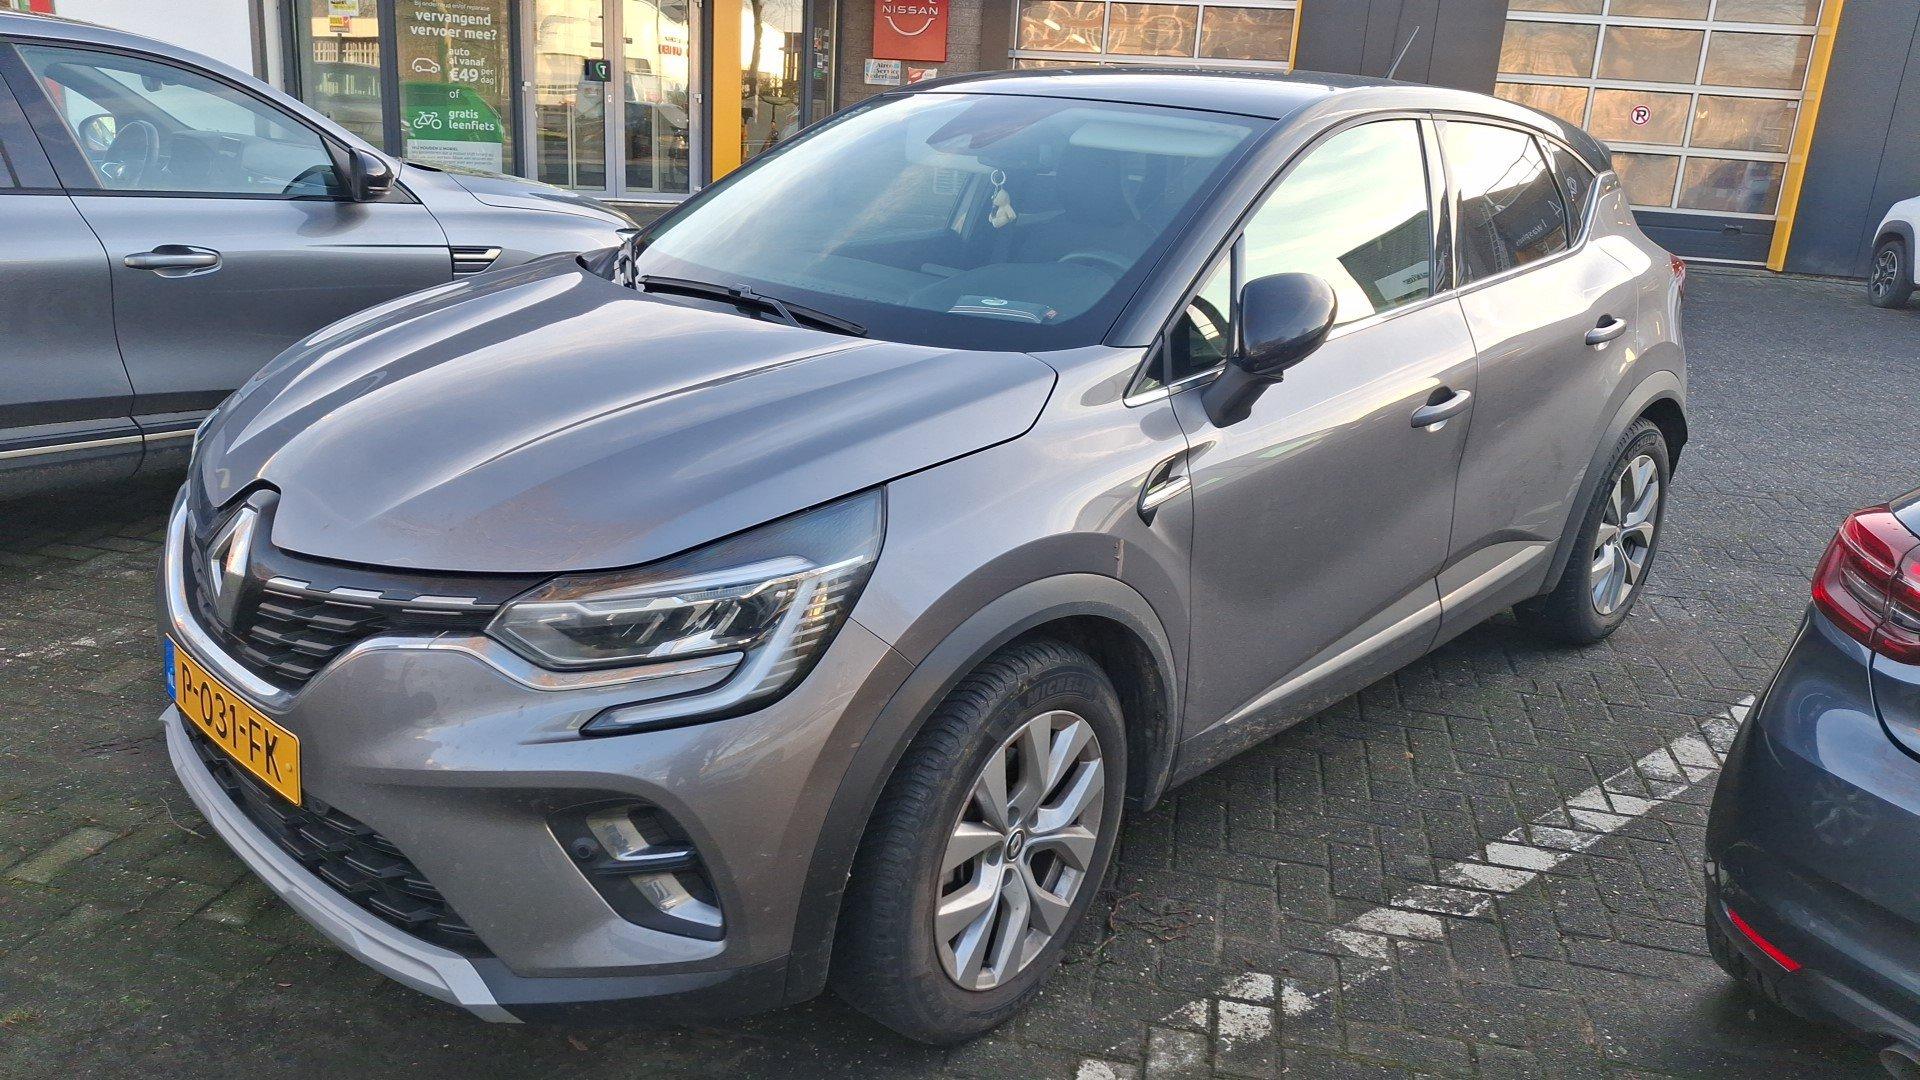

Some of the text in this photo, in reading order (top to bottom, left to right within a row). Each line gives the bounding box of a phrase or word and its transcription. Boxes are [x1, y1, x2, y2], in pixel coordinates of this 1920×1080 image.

[882, 5, 939, 15] NISSAN
[415, 11, 491, 26] vervangend
[409, 25, 497, 40] vervoer mee?
[448, 48, 470, 56] auto
[448, 56, 486, 67] al vanaf
[449, 68, 479, 82] €49
[480, 77, 494, 85] dag
[449, 89, 460, 99] of
[448, 109, 479, 120] gratis
[448, 119, 495, 131] leenfiets
[181, 661, 282, 784] P-031-FK
